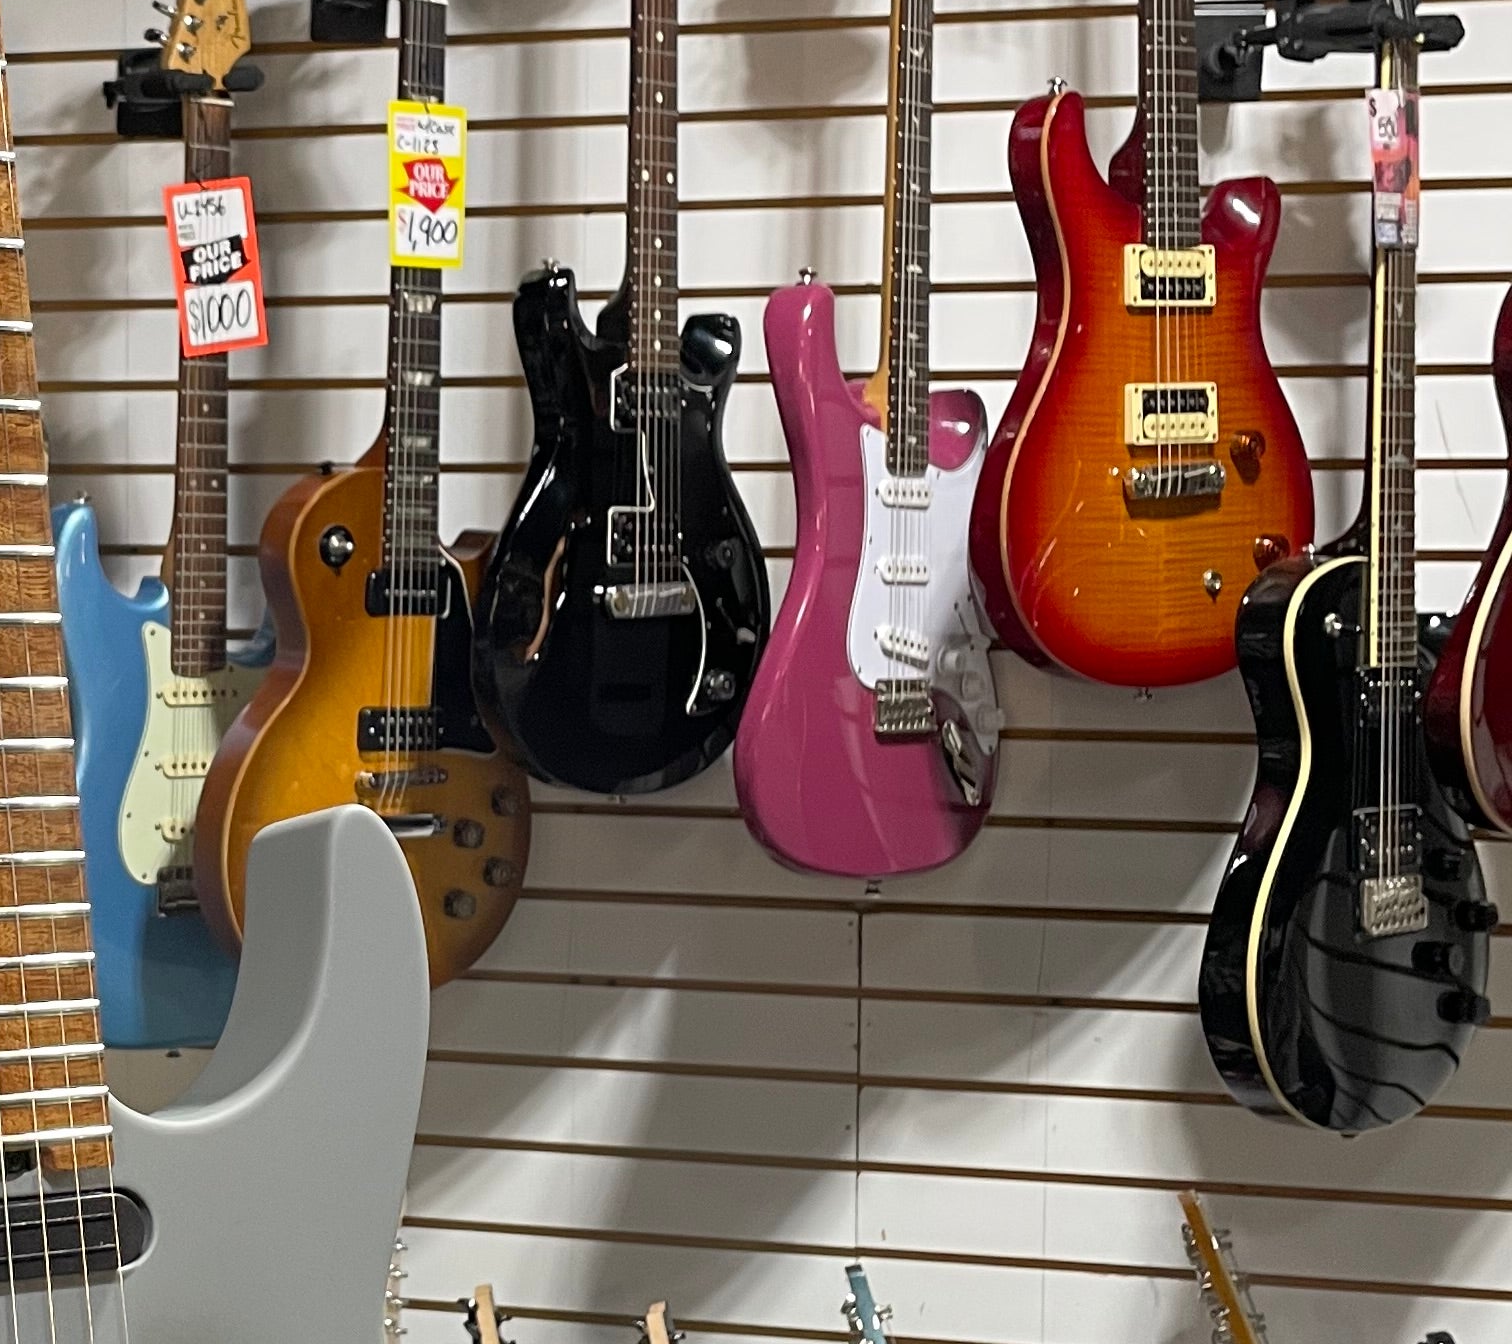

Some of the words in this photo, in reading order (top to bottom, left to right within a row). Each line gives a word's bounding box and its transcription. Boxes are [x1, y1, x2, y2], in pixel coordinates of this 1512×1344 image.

[412, 161, 445, 182] OUR
[408, 177, 450, 198] PRICE
[192, 238, 232, 264] OUR
[189, 252, 243, 283] PRICE
[189, 288, 251, 342] $1000
